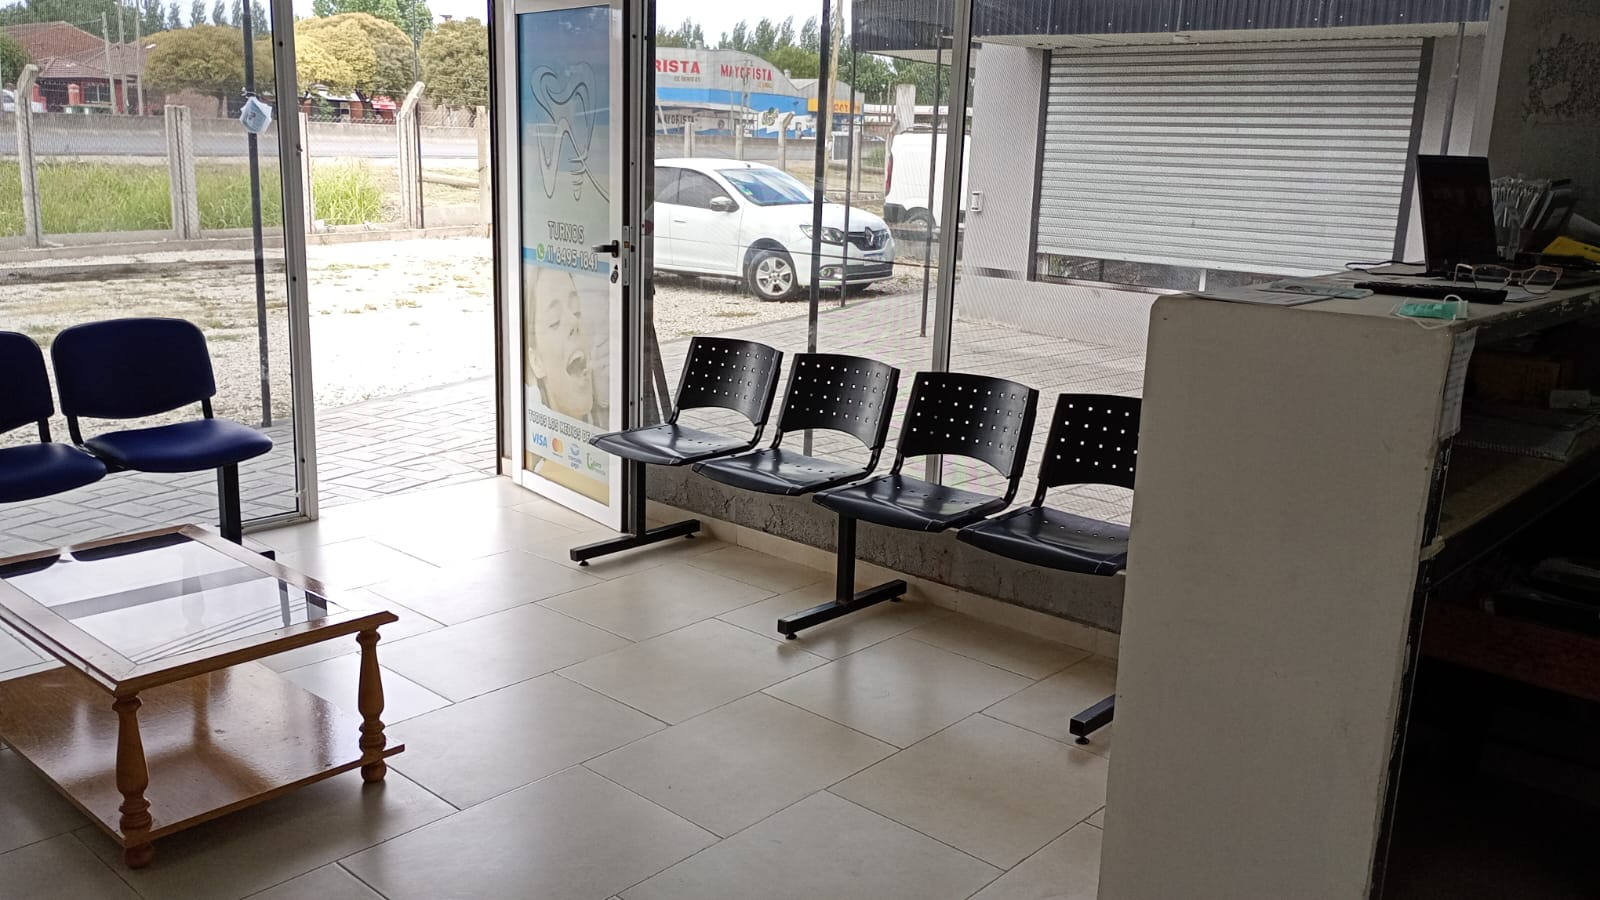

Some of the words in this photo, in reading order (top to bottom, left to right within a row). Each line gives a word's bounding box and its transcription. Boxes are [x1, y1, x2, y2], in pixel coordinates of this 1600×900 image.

[547, 221, 585, 244] TURNOS
[547, 244, 554, 264] 11
[556, 246, 578, 268] 6495
[528, 409, 548, 428] TODOS
[547, 416, 559, 433] LOS
[559, 420, 581, 441] MEDIOS
[532, 432, 548, 449] VISA
